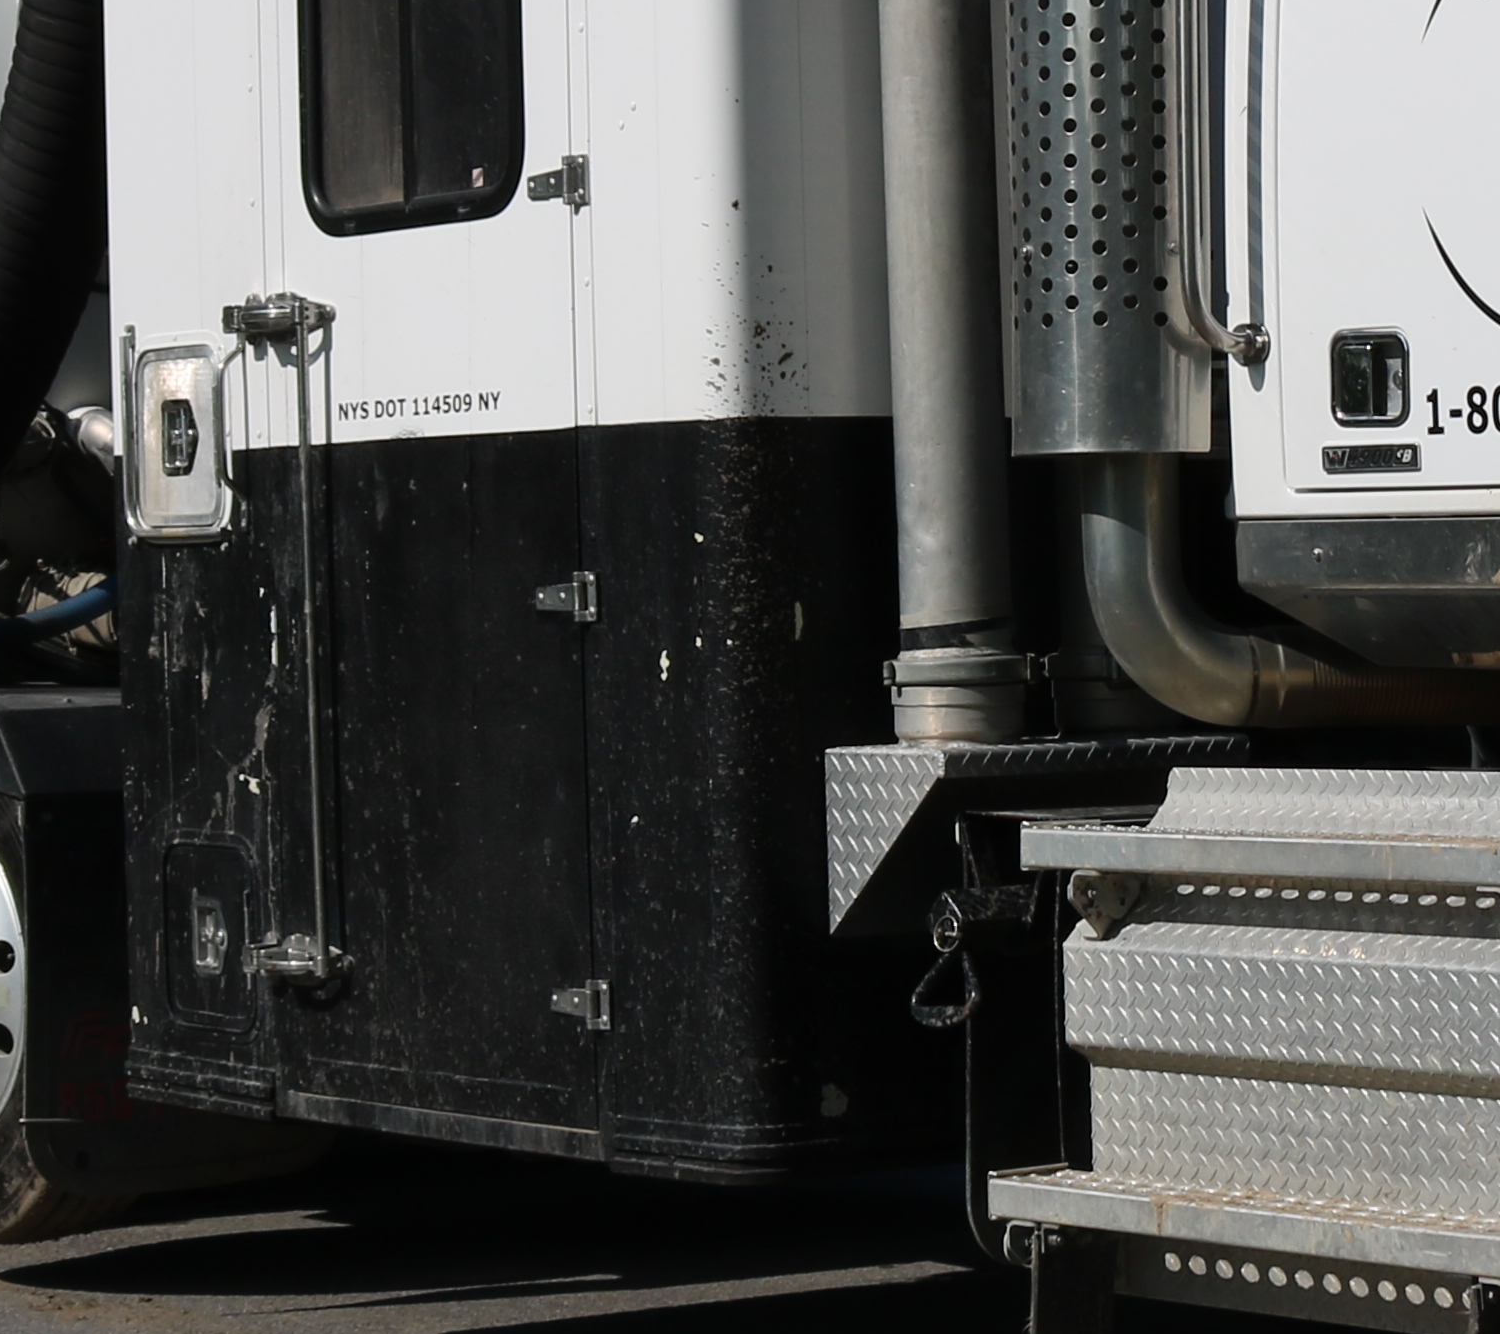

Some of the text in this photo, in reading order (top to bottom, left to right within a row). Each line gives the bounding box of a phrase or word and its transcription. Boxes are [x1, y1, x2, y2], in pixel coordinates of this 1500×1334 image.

[338, 391, 501, 421] NYS DOT 114509 NY
